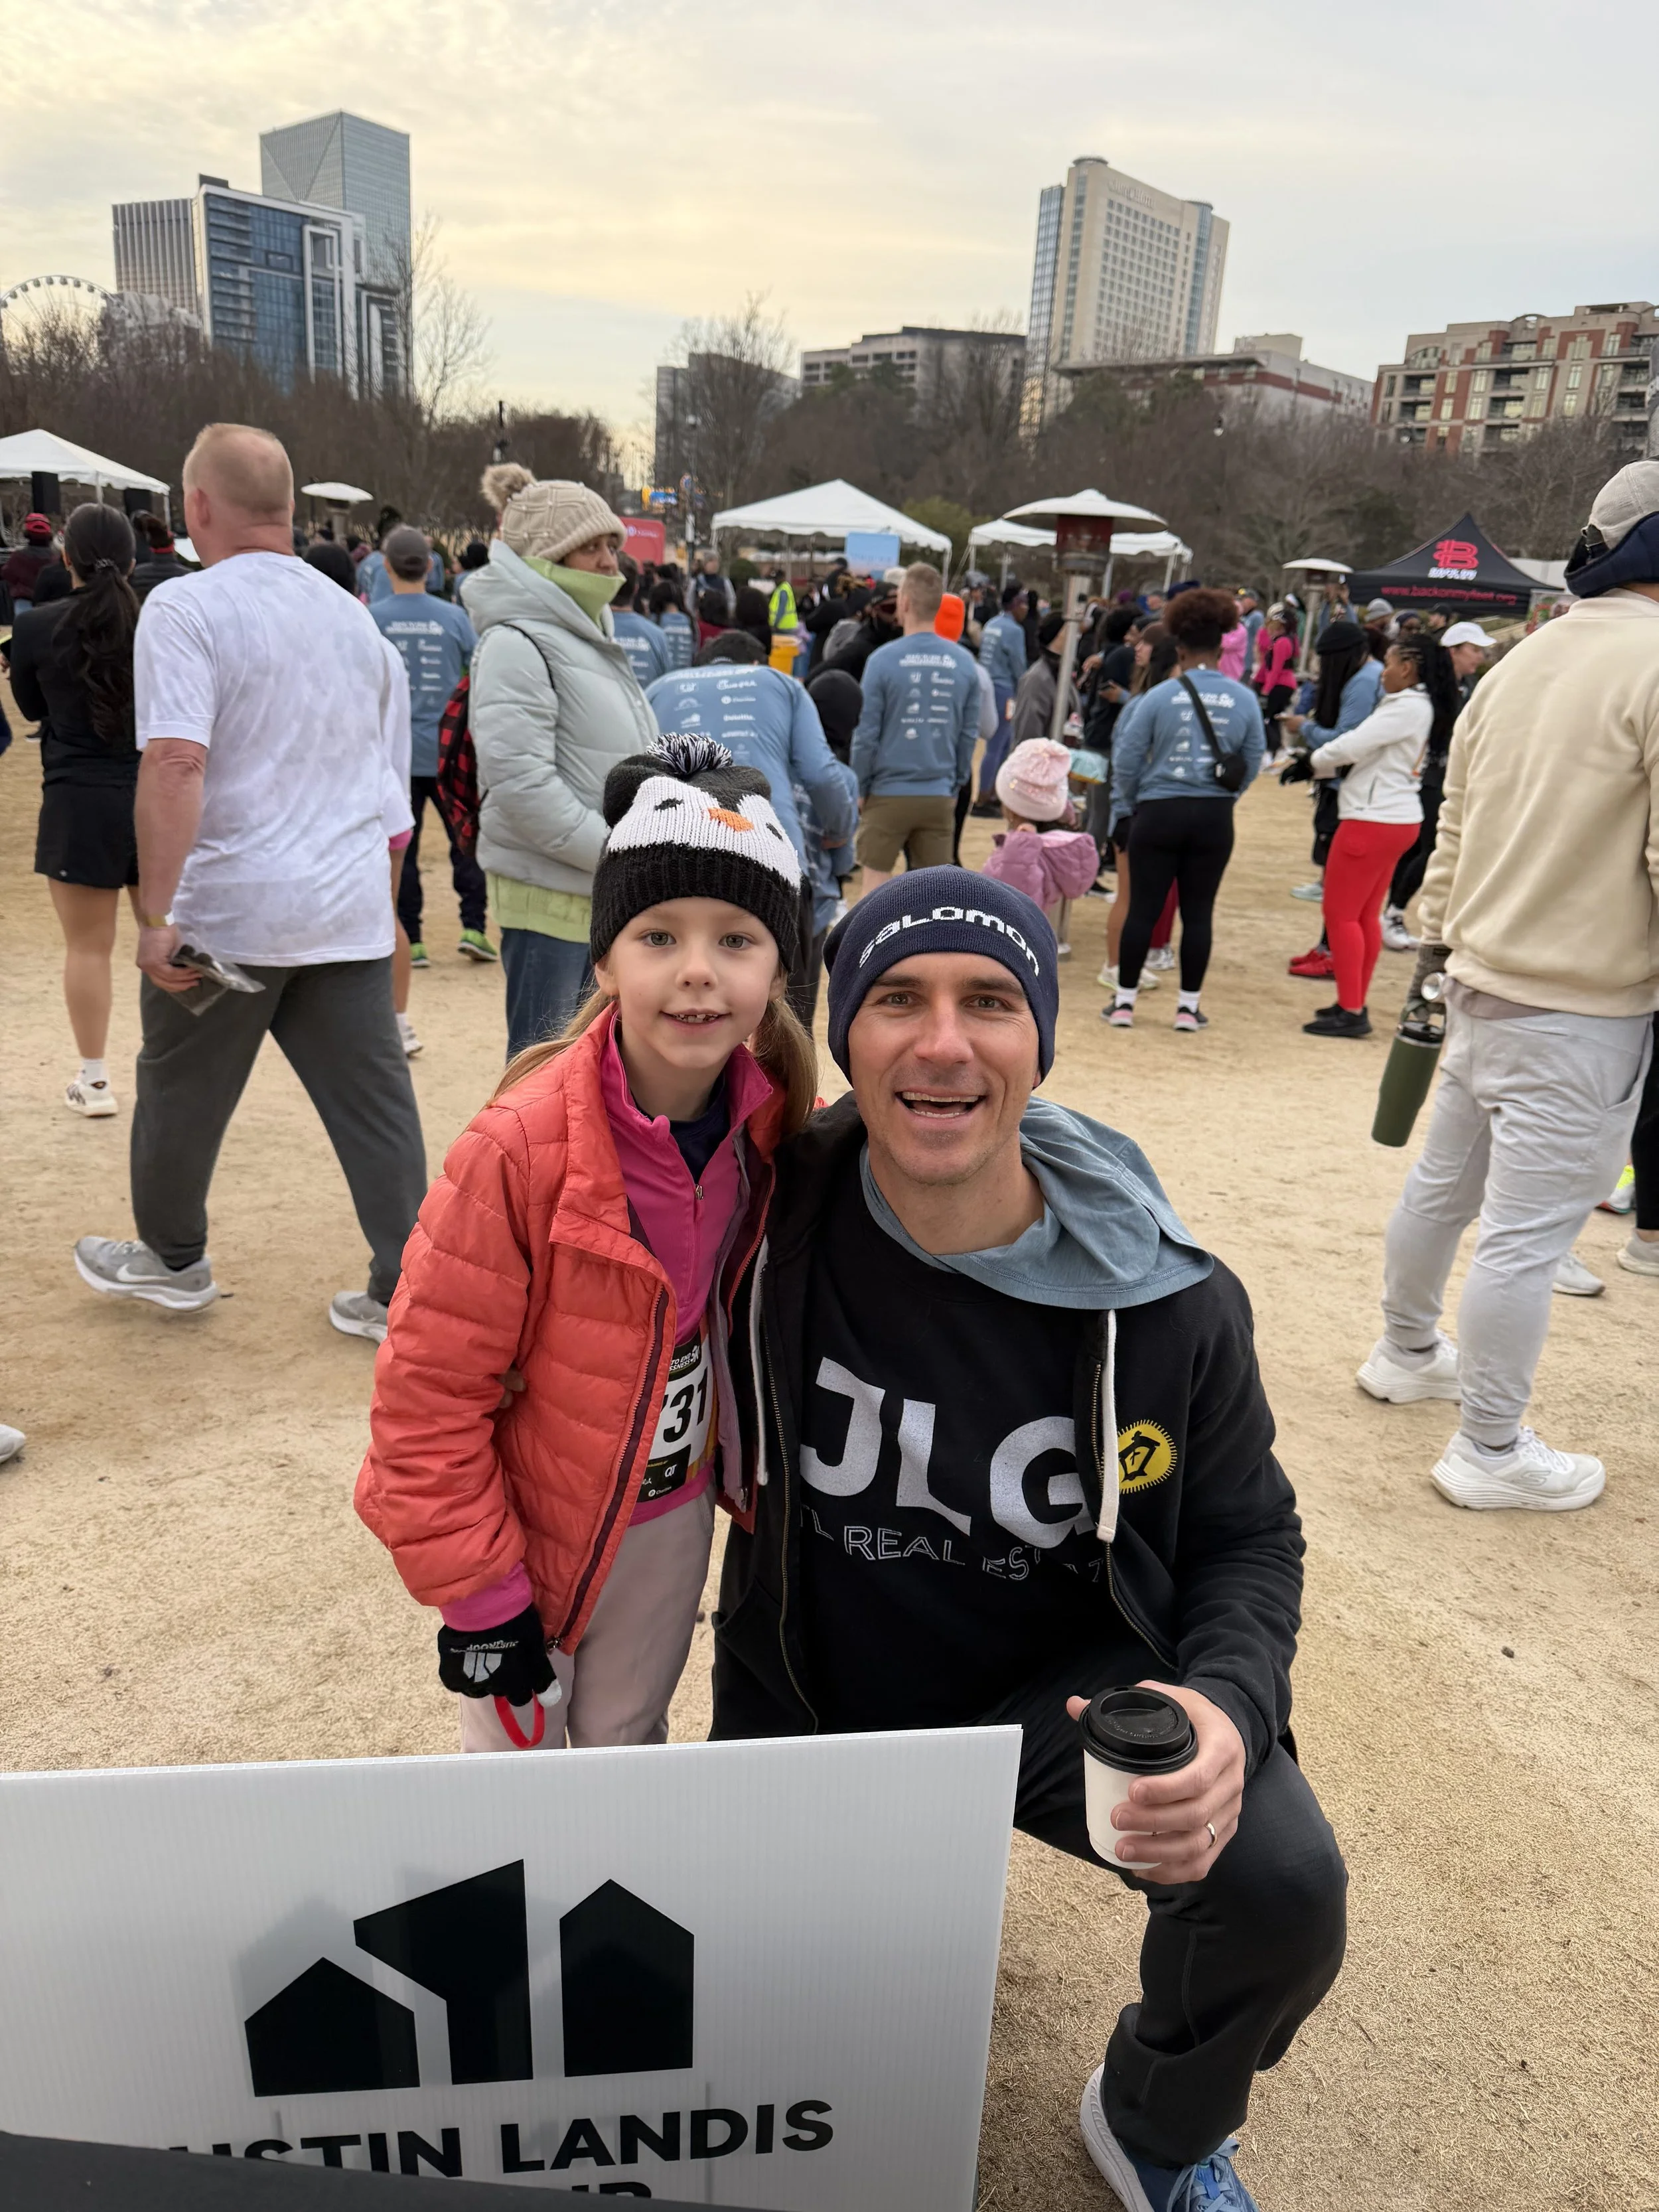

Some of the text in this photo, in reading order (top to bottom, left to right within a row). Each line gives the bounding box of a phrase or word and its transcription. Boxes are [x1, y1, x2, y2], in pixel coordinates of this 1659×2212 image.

[664, 1464, 678, 1477] QT
[800, 1357, 1096, 1549] JLG
[844, 1525, 966, 1566] REAL
[500, 2099, 834, 2174] LANDIS
